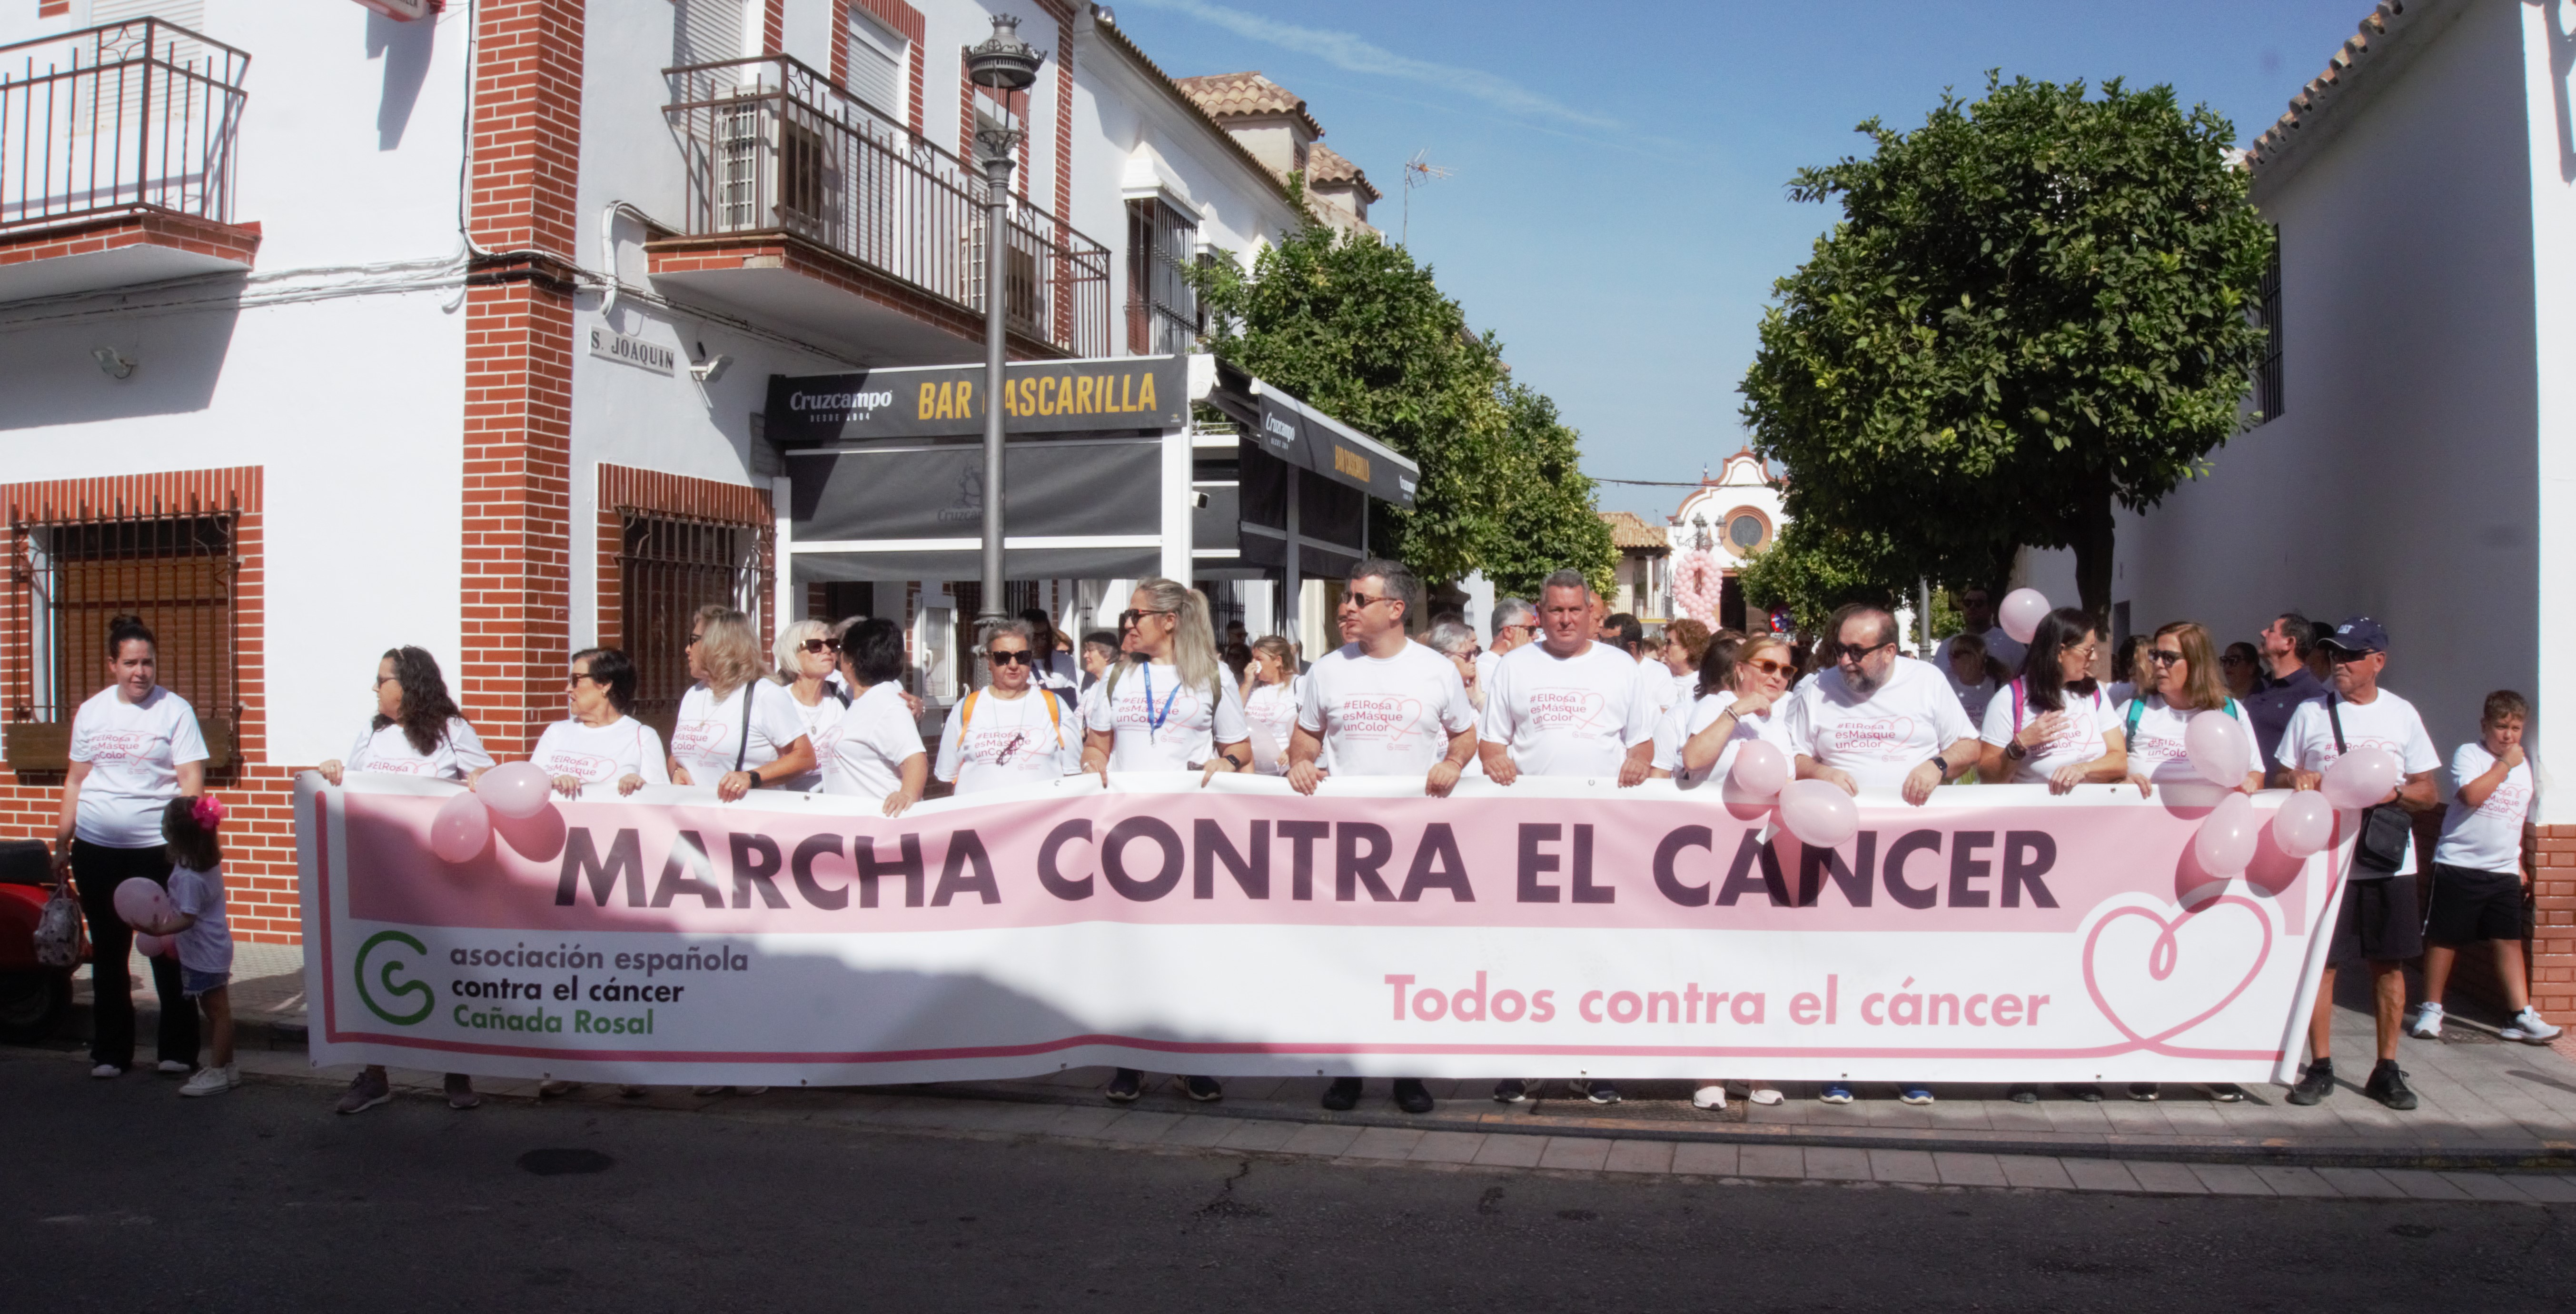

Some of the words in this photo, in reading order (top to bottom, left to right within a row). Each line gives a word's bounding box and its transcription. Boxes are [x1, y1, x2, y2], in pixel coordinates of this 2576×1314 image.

[591, 331, 604, 350] S.
[611, 337, 674, 369] JOAQUIN
[790, 390, 892, 410] Cruzcampo
[919, 381, 972, 420] BAR
[982, 373, 1157, 417] ASCARILLA
[811, 413, 839, 422] DESDE
[1530, 694, 1576, 703] #ElRosa
[1343, 700, 1392, 709] #ElRosa
[1530, 703, 1586, 714] esMásque
[1343, 711, 1403, 723] esMásque
[1533, 713, 1574, 724] unColor
[1344, 722, 1389, 731] unColor
[1836, 739, 1883, 749] unColor
[2148, 748, 2187, 757] unColo
[366, 762, 408, 772] #ElRosa
[555, 827, 1001, 911] MARCHA
[1037, 815, 1476, 902] CONTRA
[1516, 823, 1615, 904] EL
[450, 942, 604, 969] asociación
[614, 945, 748, 977] española
[452, 978, 542, 1000] contra
[553, 975, 578, 1000] el
[589, 977, 684, 1002] cáncer
[1385, 970, 1556, 1023] Todos
[1578, 983, 1765, 1025] contra
[1789, 974, 1838, 1025] el
[1861, 976, 2050, 1026] cáncer
[454, 1004, 562, 1033] Cañada
[575, 1008, 653, 1034] Rosal
